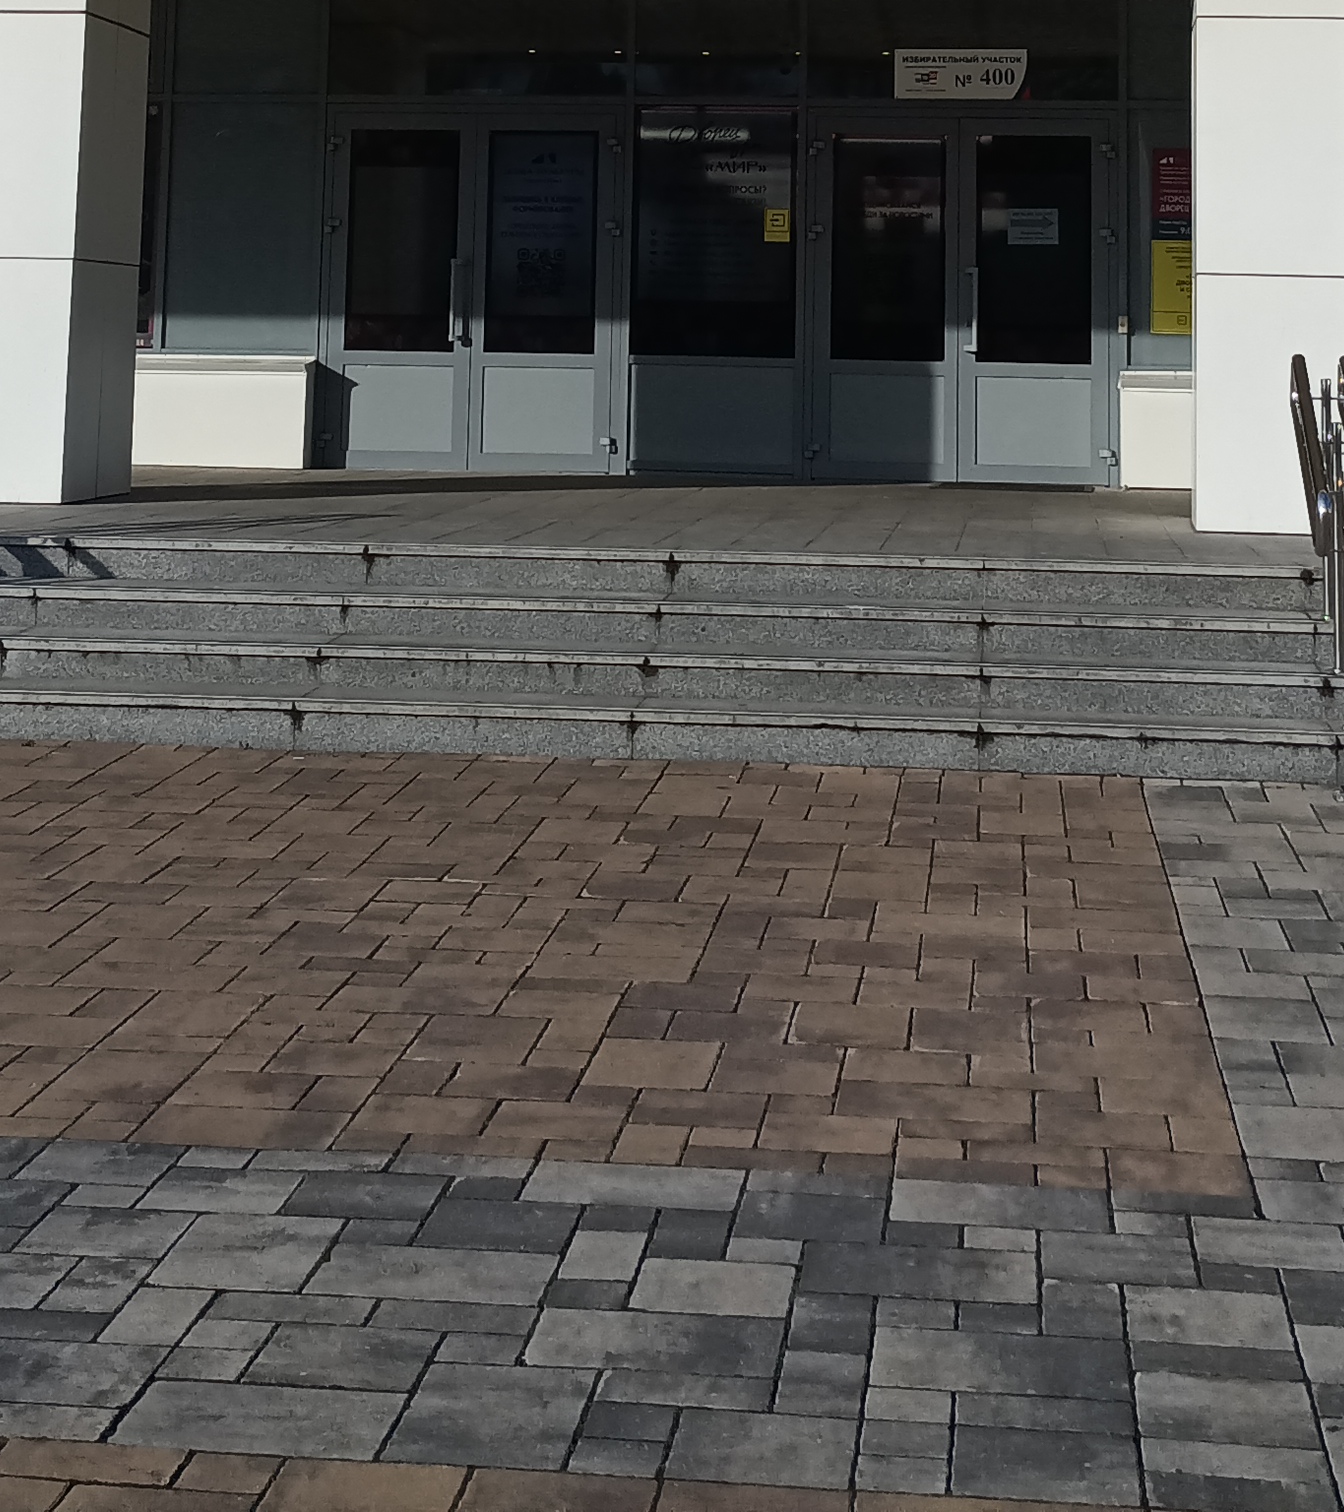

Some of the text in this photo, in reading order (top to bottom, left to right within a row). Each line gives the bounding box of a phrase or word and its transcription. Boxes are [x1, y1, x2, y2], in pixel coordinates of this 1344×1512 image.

[902, 54, 1023, 64] ИЗБИРАТЕЛЬНЫЙ УЧАСТОК
[955, 68, 1015, 88] № 400
